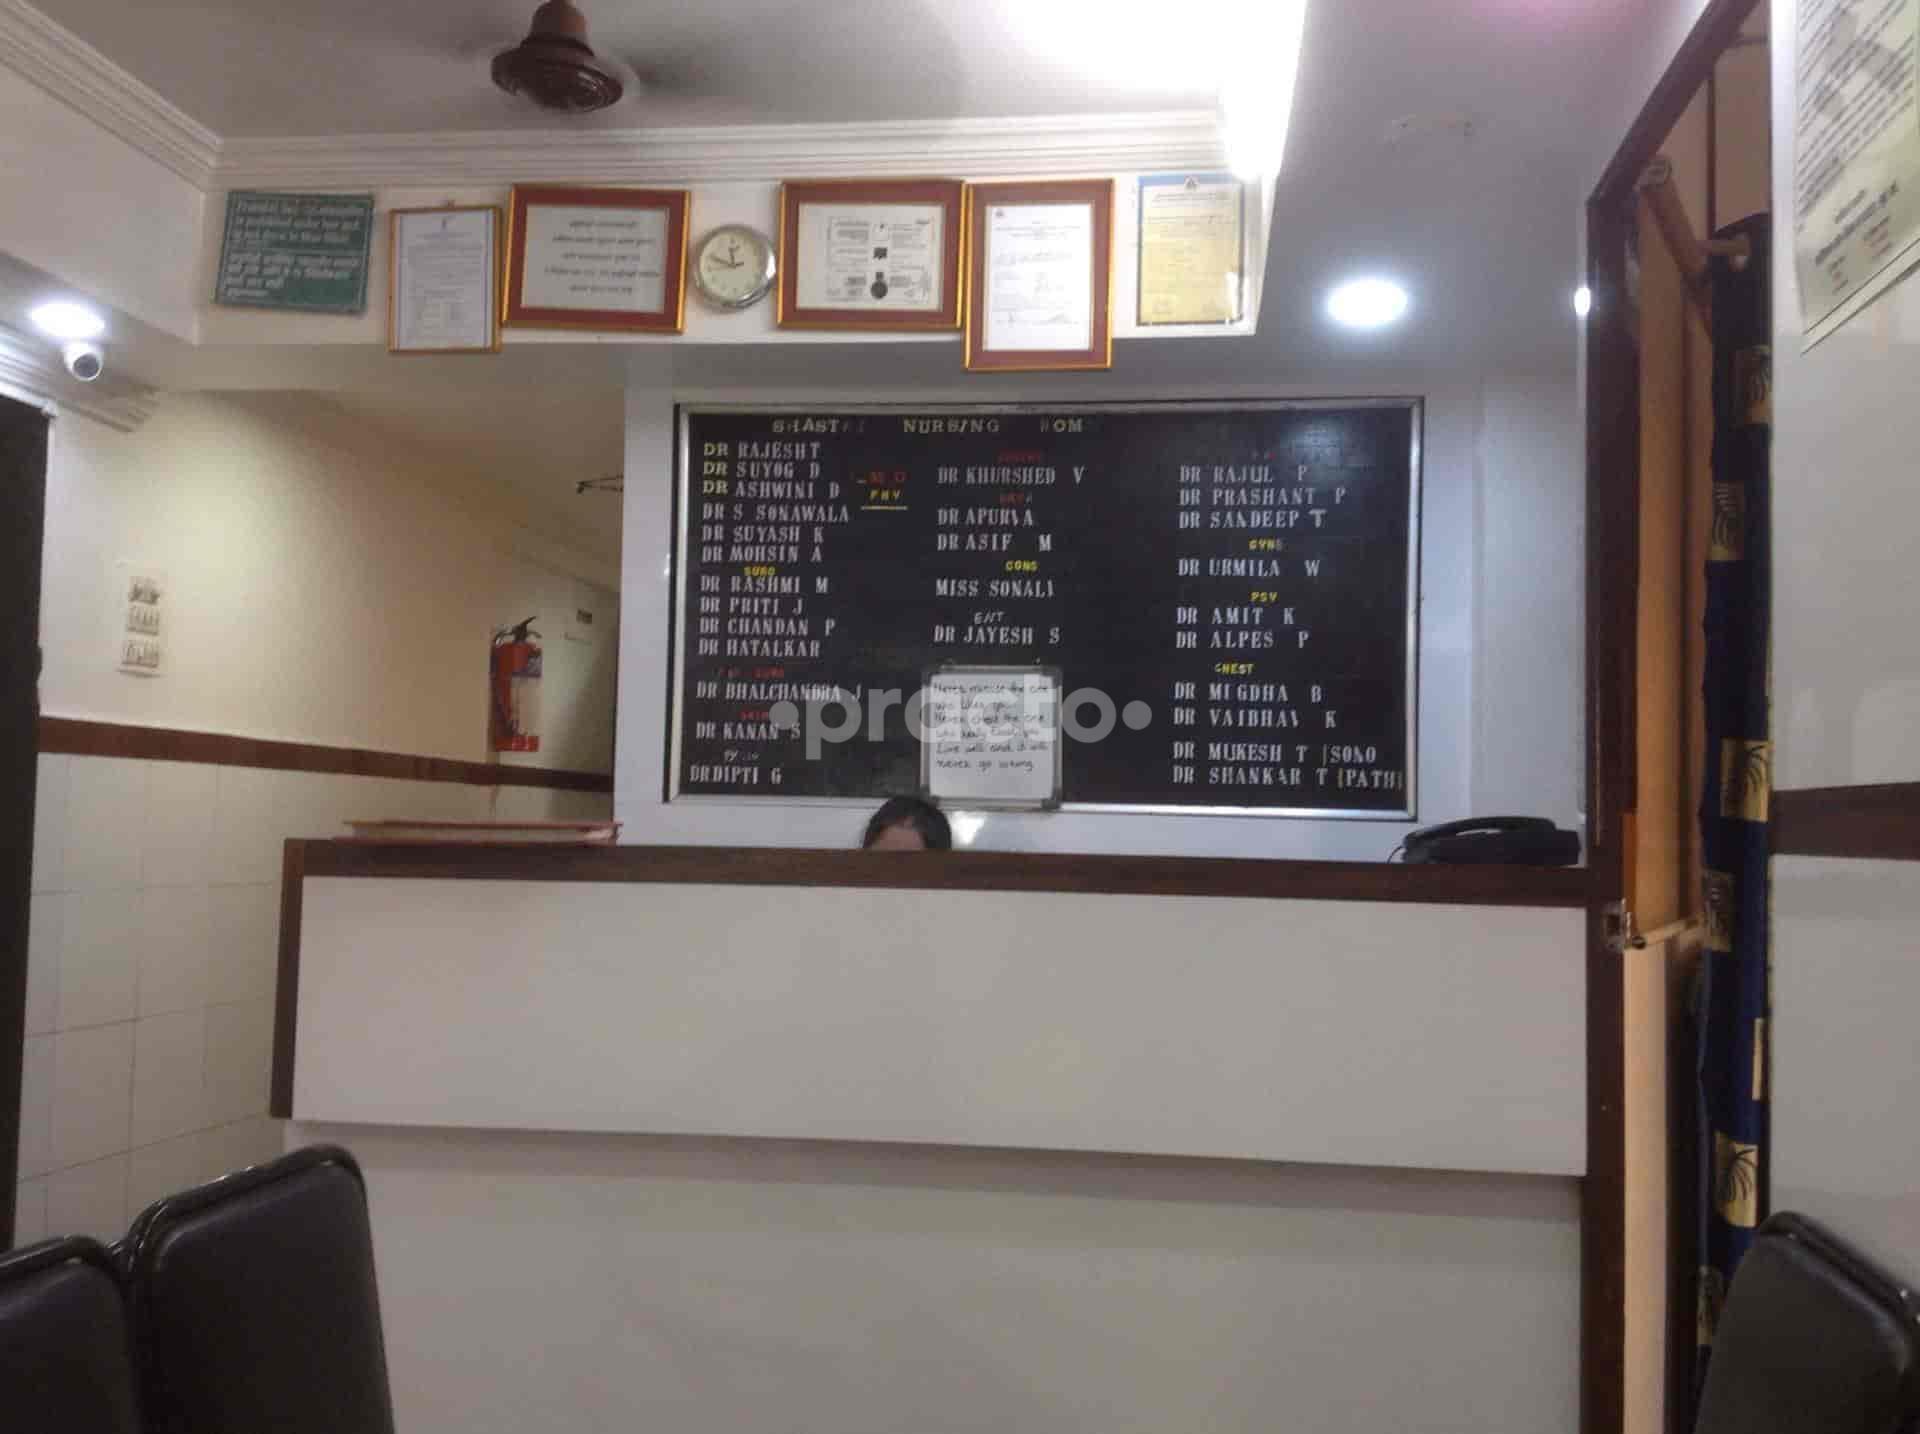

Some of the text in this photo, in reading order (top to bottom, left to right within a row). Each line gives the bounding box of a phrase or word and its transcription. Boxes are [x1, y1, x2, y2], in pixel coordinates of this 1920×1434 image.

[903, 418, 1001, 434] NURSING
[703, 442, 728, 457] DR
[703, 461, 820, 479] DR SUYOG D
[938, 466, 1085, 485] DR KHURSHED V
[1180, 465, 1308, 483] DR RAJUL P
[703, 480, 840, 499] DR ASHWINI D
[1179, 488, 1347, 506] DR PRASHANT P
[702, 504, 850, 523] DR S SONAWALA
[938, 508, 960, 526] DR
[1179, 508, 1328, 529] DR SANDEEP T
[702, 526, 825, 544] DR SUYASH K
[937, 533, 1053, 553] DR ASIF M
[701, 545, 823, 564] DR MOHSIN A
[1178, 558, 1320, 577] DR URMILA W
[700, 574, 829, 594] DR RASHMI M
[934, 578, 979, 596] MISS
[700, 596, 803, 615] DR PRITI J
[699, 615, 835, 636] DR CHANDAN P
[1176, 607, 1294, 625] DR AMIT K
[933, 625, 1060, 645] DR JAYESH S
[1175, 631, 1309, 649] DR ALPES P
[698, 637, 720, 656] DR
[696, 680, 717, 699] DR
[1174, 681, 1196, 699] DR
[1310, 685, 1322, 703] B
[1173, 707, 1196, 726] DR
[1325, 711, 1337, 729] K
[695, 721, 716, 739] DR
[722, 722, 780, 741] KANAN
[1173, 742, 1195, 760] DR
[1208, 743, 1282, 762] MUKESH
[1296, 745, 1308, 763] T
[770, 768, 782, 785] G
[1172, 765, 1194, 783] DR
[1208, 767, 1301, 786] SHANKAR
[1316, 768, 1328, 786] T
